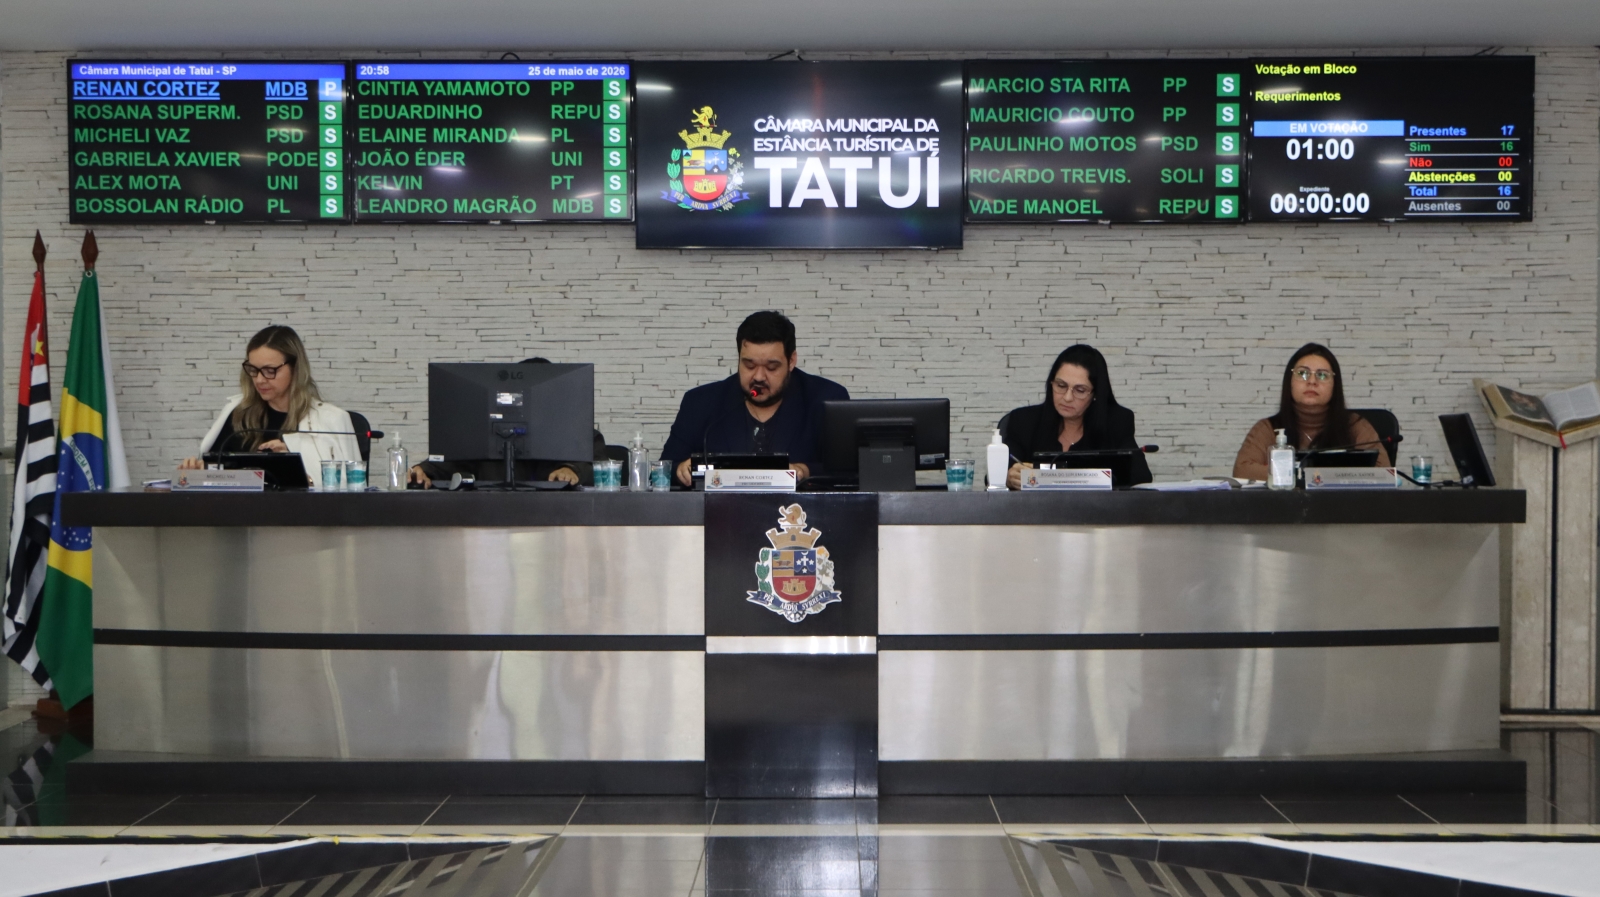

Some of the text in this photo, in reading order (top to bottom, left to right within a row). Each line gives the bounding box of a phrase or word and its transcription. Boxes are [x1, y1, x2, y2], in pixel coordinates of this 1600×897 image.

[79, 65, 119, 75] Câmara
[121, 66, 170, 78] Municipal
[173, 66, 186, 75] de
[222, 66, 236, 75] SP
[360, 66, 389, 75] 20:58
[528, 67, 625, 76] 25 de maio de 2026
[1255, 65, 1300, 76] Votação
[1324, 64, 1356, 74] Bloco
[74, 81, 337, 96] RENAN CORTEZ MDB P
[358, 81, 621, 96] CINTIA YAMAMOTO PP S
[970, 77, 1234, 93] MARCIO STA RITA PP S
[1255, 91, 1341, 103] Requerimentos
[74, 105, 336, 120] ROSANA SUPERM. PSD S
[359, 105, 621, 120] EDUARDINHO REPU S
[970, 106, 1234, 122] MAURICIO COUTO PP S
[754, 116, 939, 132] CÂMARA MUNICIPAL DA
[1290, 122, 1368, 135] EM VOTAÇÃO
[1410, 125, 1514, 136] Presentes 17
[75, 128, 337, 144] MICHELI VAZ PSD S
[359, 128, 621, 143] ELAINE MIRANDA PL S
[754, 135, 939, 151] ESTÂNCIA TURÍSTICA DE
[970, 136, 1234, 151] PAULINHO MOTOS PSD S
[1286, 139, 1354, 160] 01:00
[1409, 142, 1513, 151] Sim 16
[75, 152, 337, 167] GABRIELA XAVIER PODE S
[358, 148, 621, 166] JOÃO ÉDER UNI S
[1409, 157, 1512, 167] Não 00
[75, 175, 337, 191] ALEX MOTA UNI S
[358, 175, 621, 190] KELVIN PT S
[754, 151, 939, 208] TATUÍ
[970, 168, 1233, 184] RICARDO TREVIS. SOLI S
[1409, 172, 1512, 184] Abstenções 00
[1409, 186, 1511, 196] Total 16
[75, 195, 338, 214] BOSSOLAN RÁDIO PL S
[358, 196, 621, 213] LEANDRO MAGRÃO MDB S
[970, 199, 1233, 214] VADE MANOEL REPU S
[1270, 193, 1369, 213] 00:00:00
[1409, 201, 1510, 211] Ausentes 00
[511, 372, 523, 380] LG
